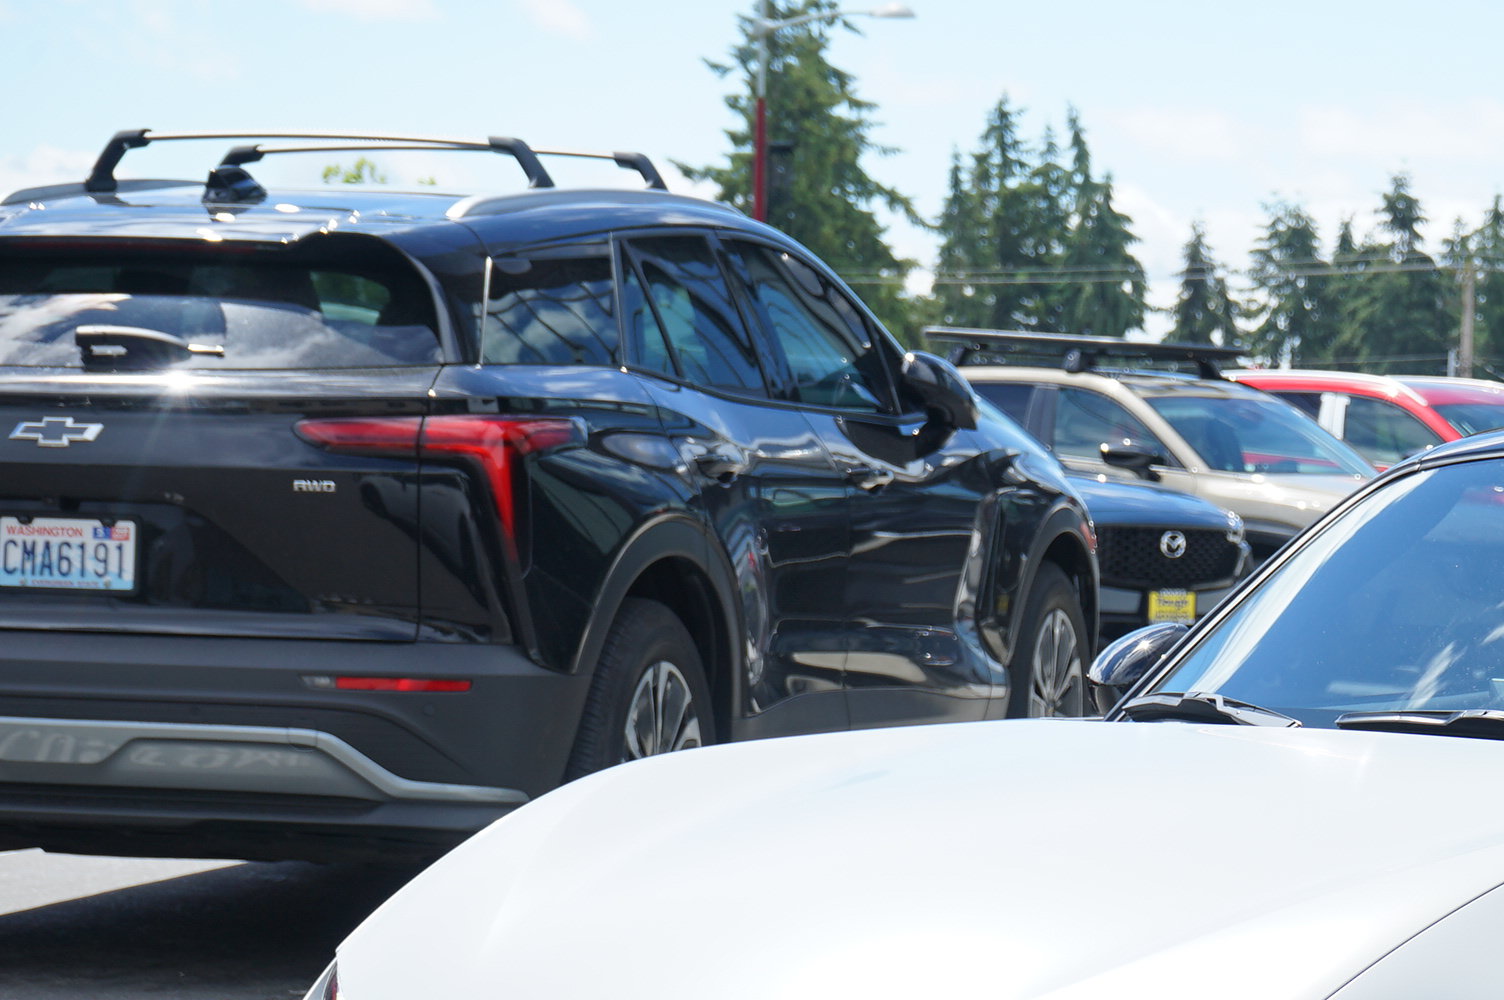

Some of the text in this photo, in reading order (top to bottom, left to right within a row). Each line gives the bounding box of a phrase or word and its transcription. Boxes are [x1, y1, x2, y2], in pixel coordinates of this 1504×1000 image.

[293, 479, 336, 492] RWD
[6, 525, 83, 537] WASHINGTON
[3, 539, 124, 579] CMA6191
